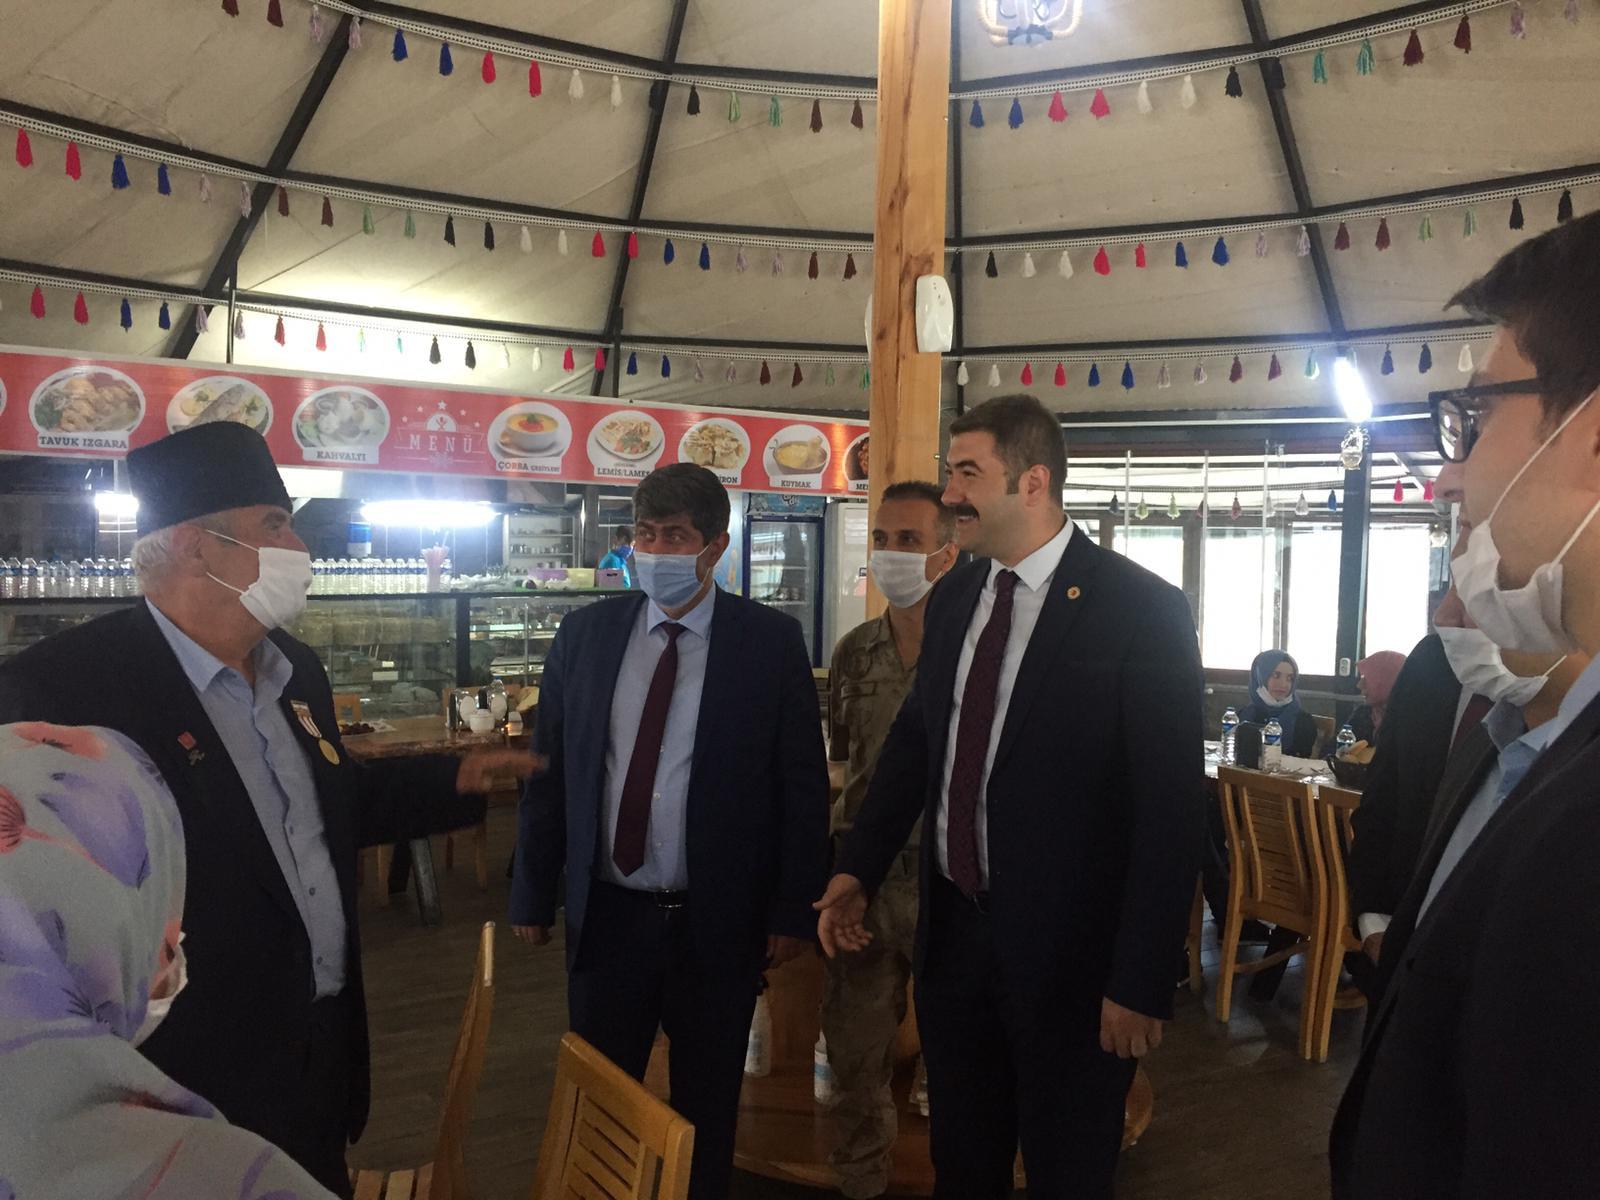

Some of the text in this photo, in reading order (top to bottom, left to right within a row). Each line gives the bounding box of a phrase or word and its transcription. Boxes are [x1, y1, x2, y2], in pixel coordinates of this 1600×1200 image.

[39, 436, 128, 449] TAVUK IZGARA
[409, 433, 472, 453] MENÜ
[316, 450, 367, 461] KAHVALTI
[780, 480, 812, 488] KUYMAK
